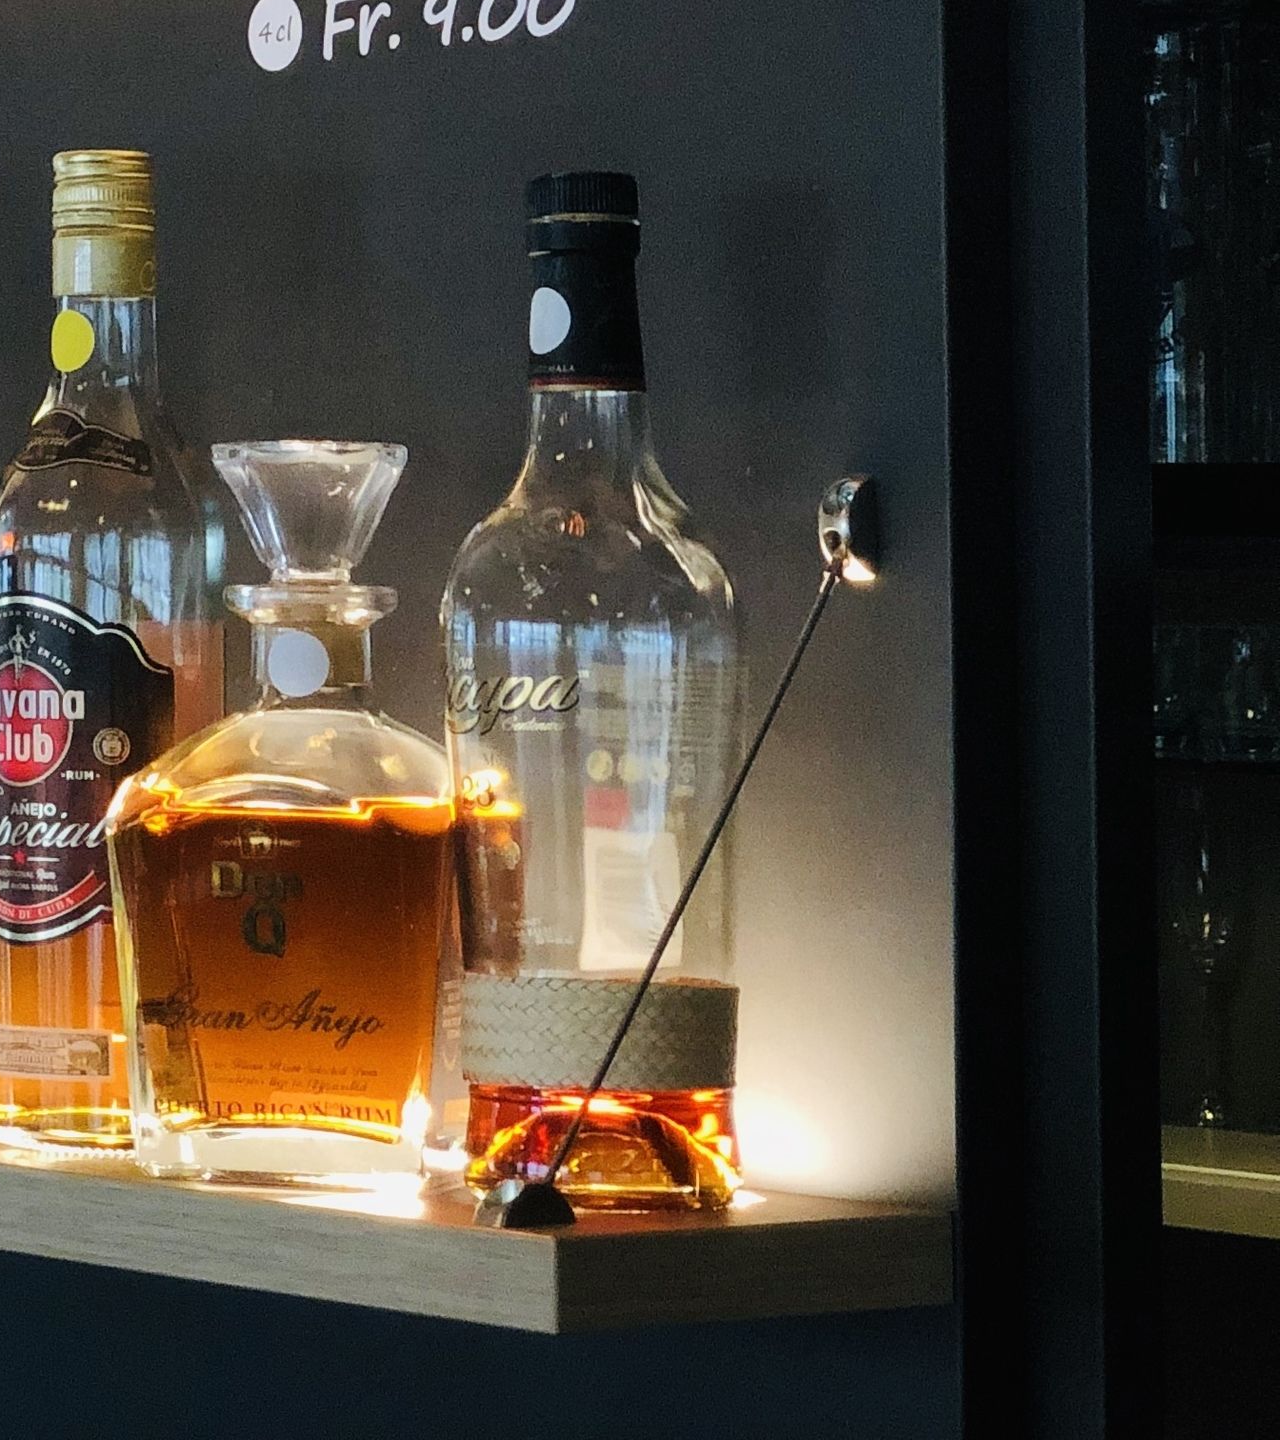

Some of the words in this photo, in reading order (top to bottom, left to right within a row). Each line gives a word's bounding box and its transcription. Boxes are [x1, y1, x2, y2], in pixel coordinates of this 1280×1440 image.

[10, 798, 57, 820] AÑEJO
[258, 988, 385, 1050] Añejo
[340, 1106, 392, 1125] RUM
